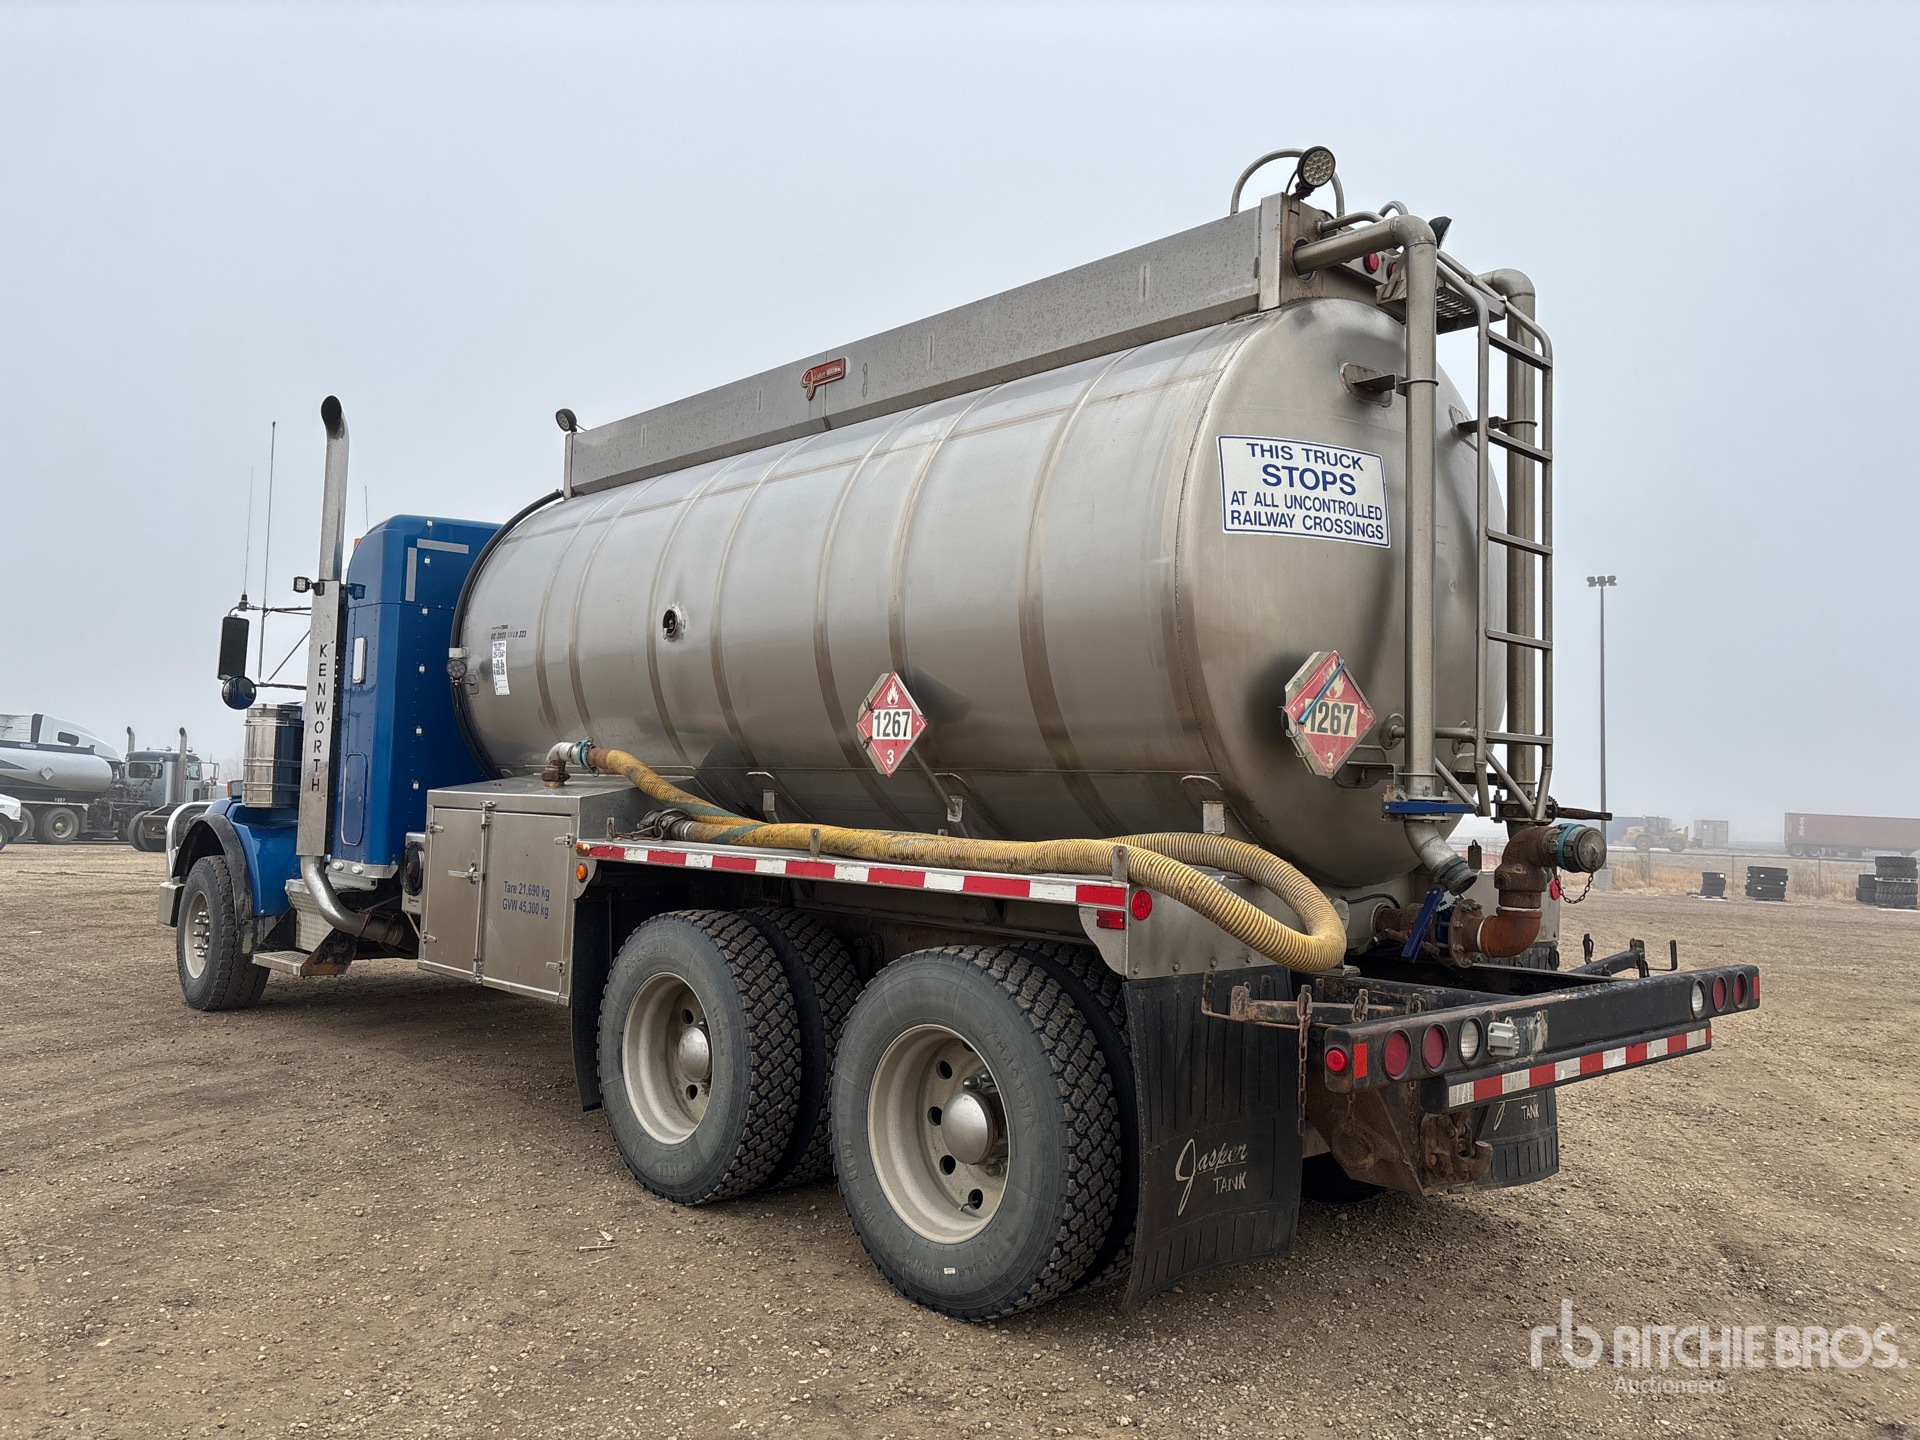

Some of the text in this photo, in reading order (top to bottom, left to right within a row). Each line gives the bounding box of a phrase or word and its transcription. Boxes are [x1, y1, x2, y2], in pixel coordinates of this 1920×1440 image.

[1246, 443, 1364, 471] THIS TRUCK
[1262, 464, 1356, 496] STOPS
[1231, 491, 1382, 521] AT ALL UNCONTROLLED
[1230, 510, 1384, 540] RAILWAY CROSSINGS
[311, 643, 328, 792] KENWORTH
[874, 711, 911, 738] 1267
[1309, 701, 1355, 736] 1267
[886, 749, 895, 765] 3
[504, 881, 550, 901] Tare 21,690 kg
[502, 898, 549, 919] GVW 45,300 kg
[1520, 1103, 1540, 1120] TANK
[1213, 1172, 1247, 1195] TANK
